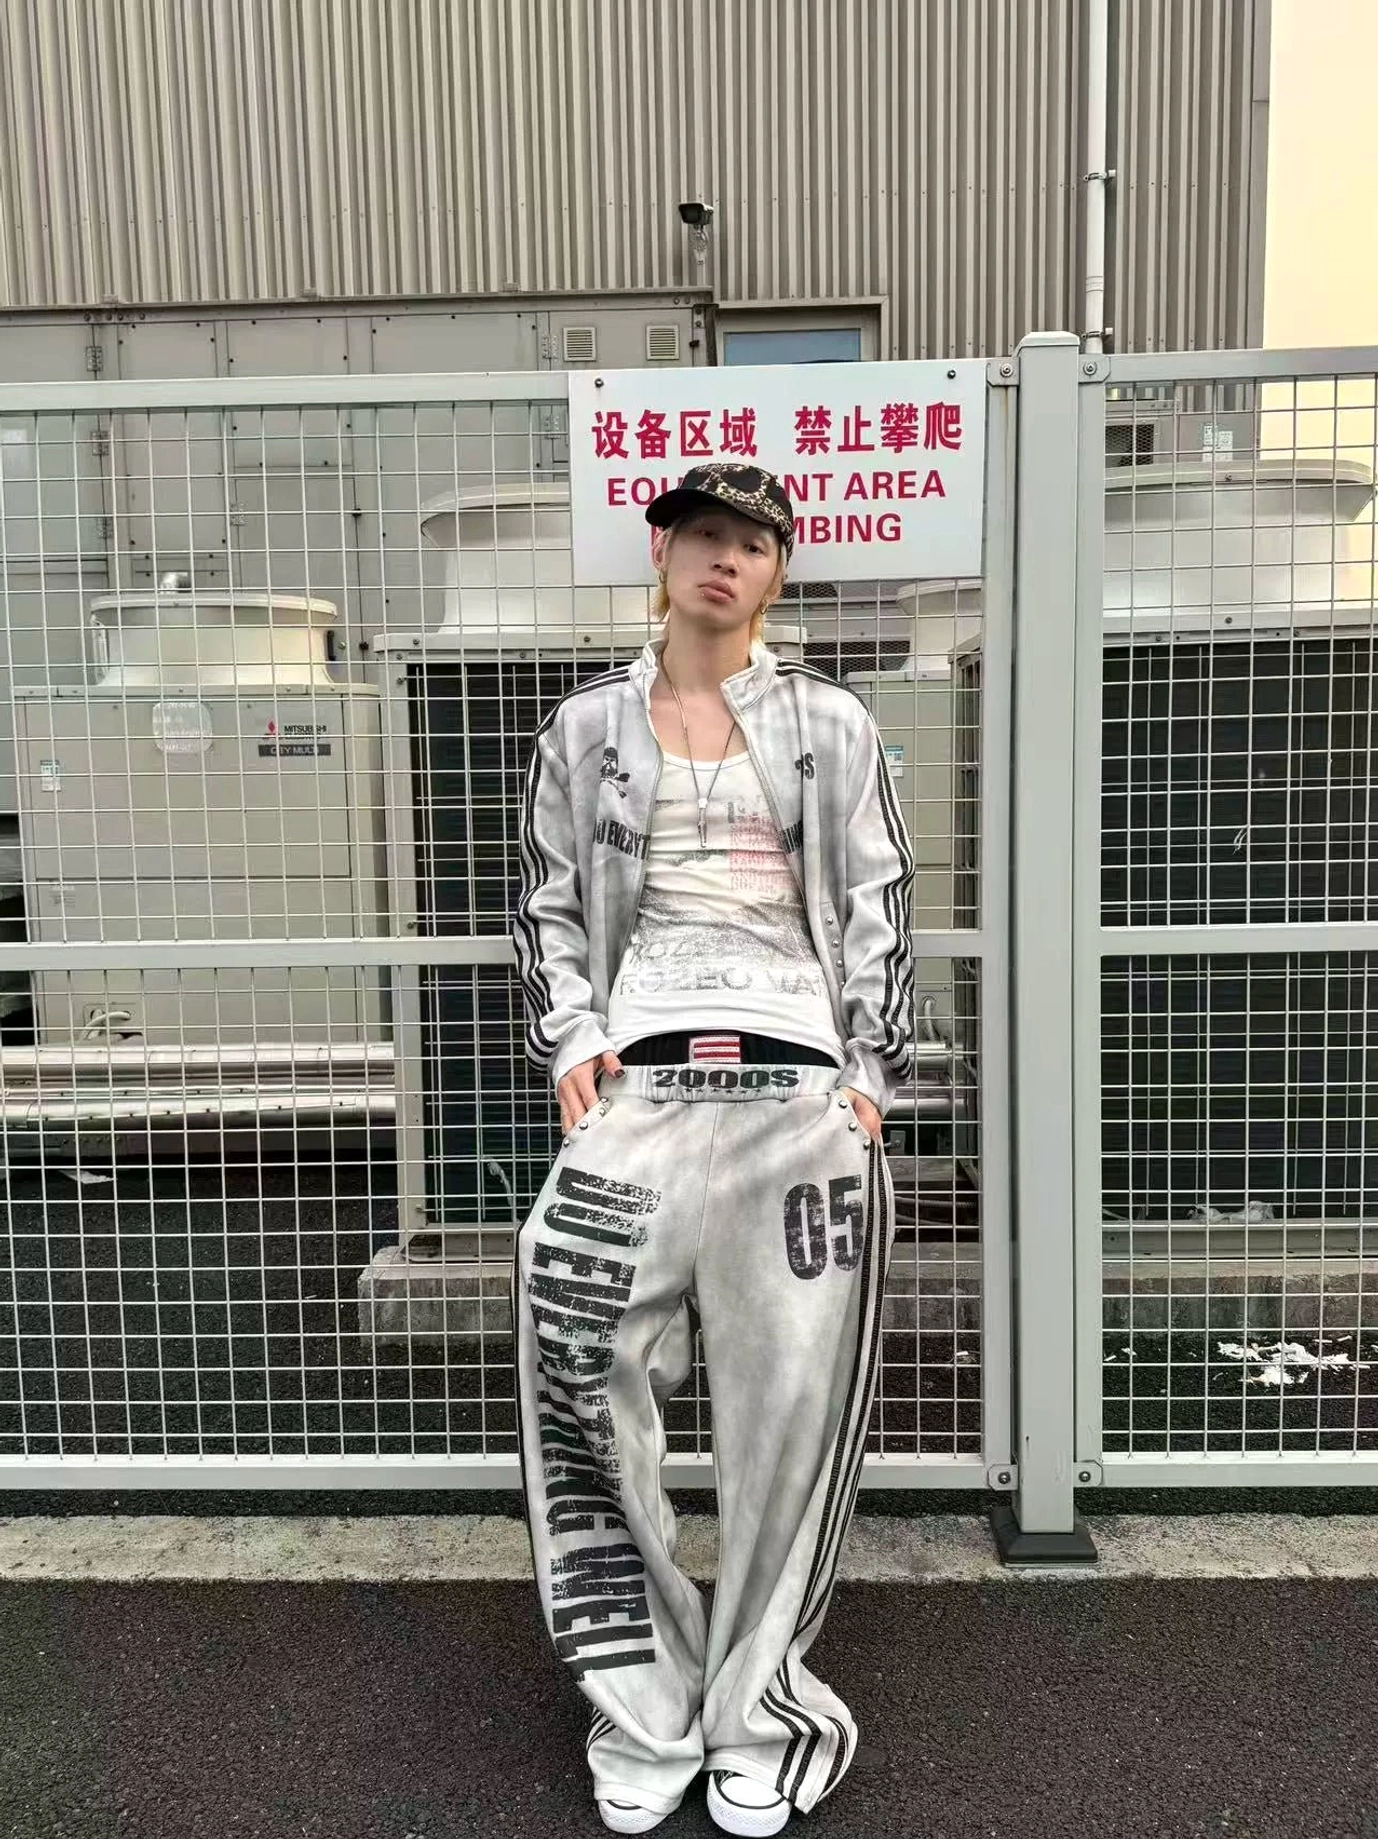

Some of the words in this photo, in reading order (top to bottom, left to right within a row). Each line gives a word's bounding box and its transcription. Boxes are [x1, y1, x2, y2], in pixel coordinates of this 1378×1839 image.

[592, 407, 758, 459] 设备区域
[794, 401, 963, 456] 禁止攀爬
[843, 469, 946, 501] AREA
[284, 725, 327, 733] MITSUBSHI
[652, 1069, 800, 1089] 2000S
[543, 1166, 663, 1247] DO
[783, 1174, 864, 1280] 05
[550, 1543, 656, 1683] WELL
